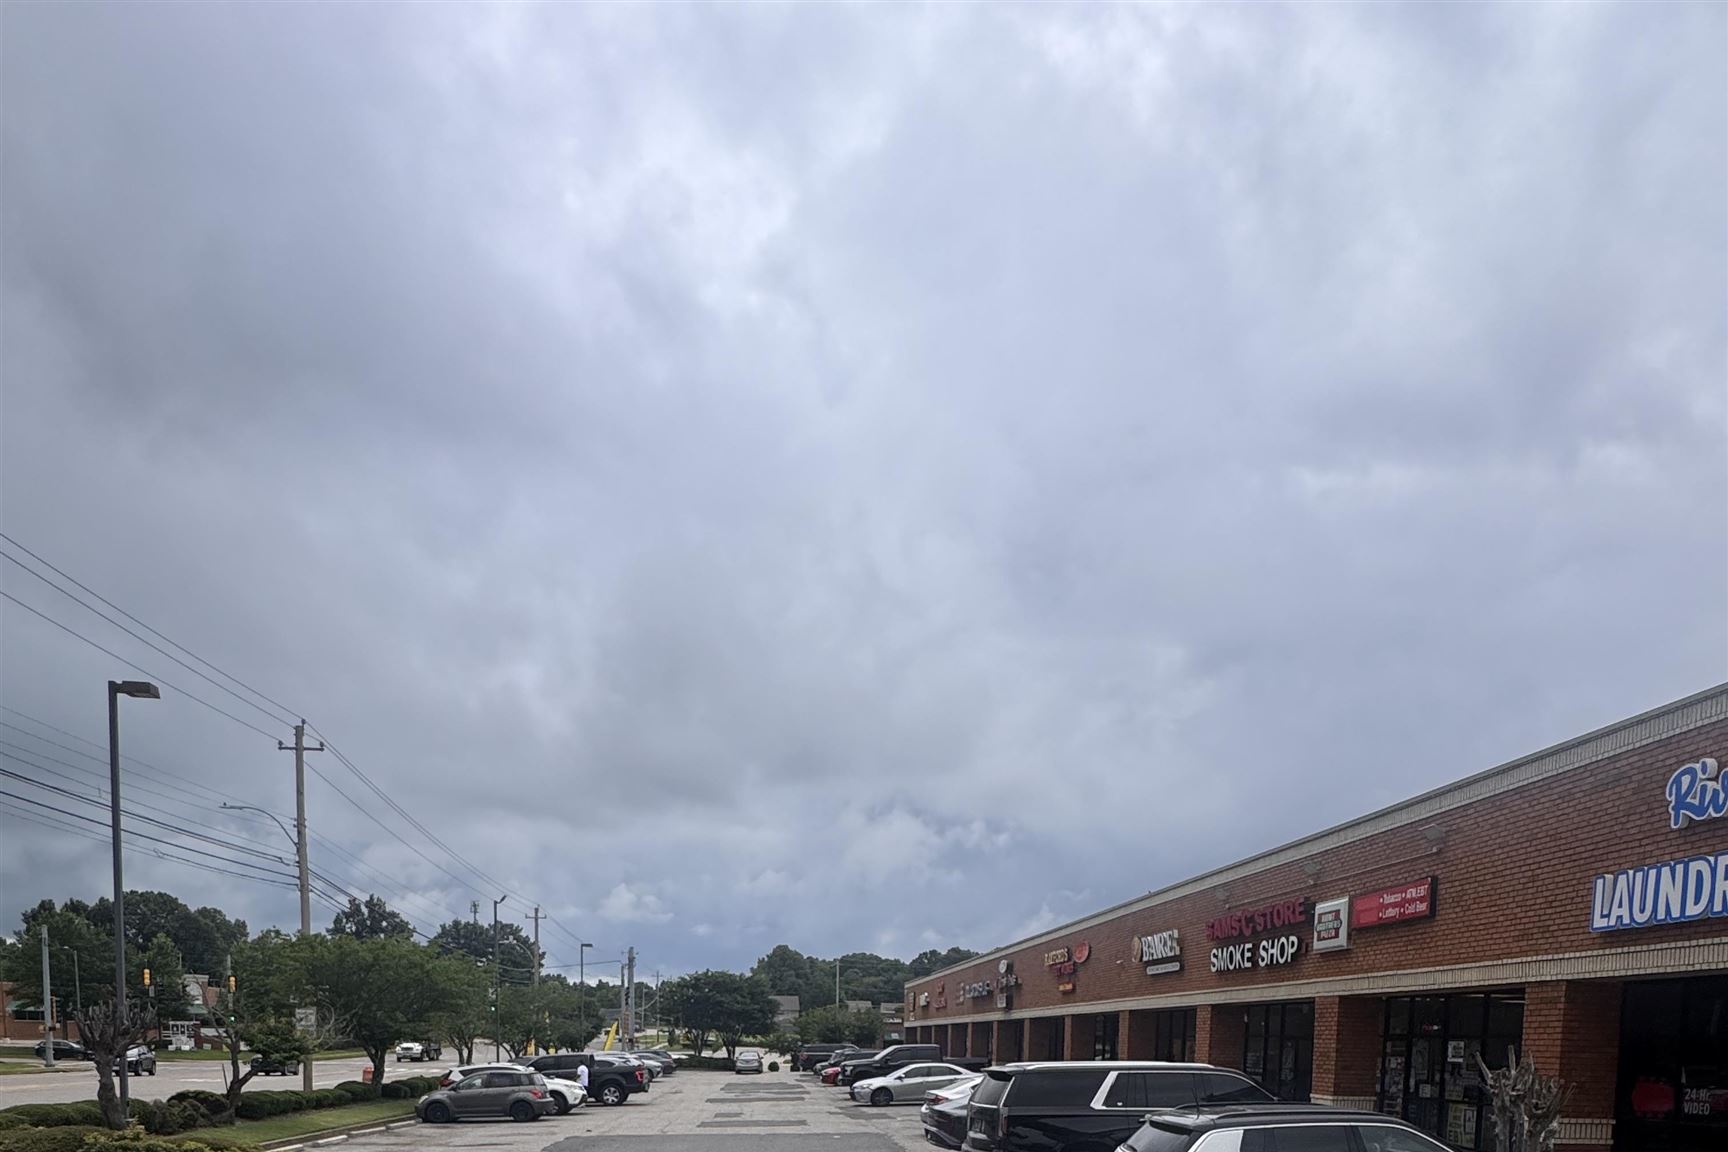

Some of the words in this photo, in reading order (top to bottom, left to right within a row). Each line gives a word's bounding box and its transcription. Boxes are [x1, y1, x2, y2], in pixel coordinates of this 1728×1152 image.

[1254, 896, 1306, 932] STORE
[1210, 943, 1253, 972] SMOKE
[1258, 935, 1299, 967] SHOP
[1683, 1102, 1711, 1115] VIDEO
